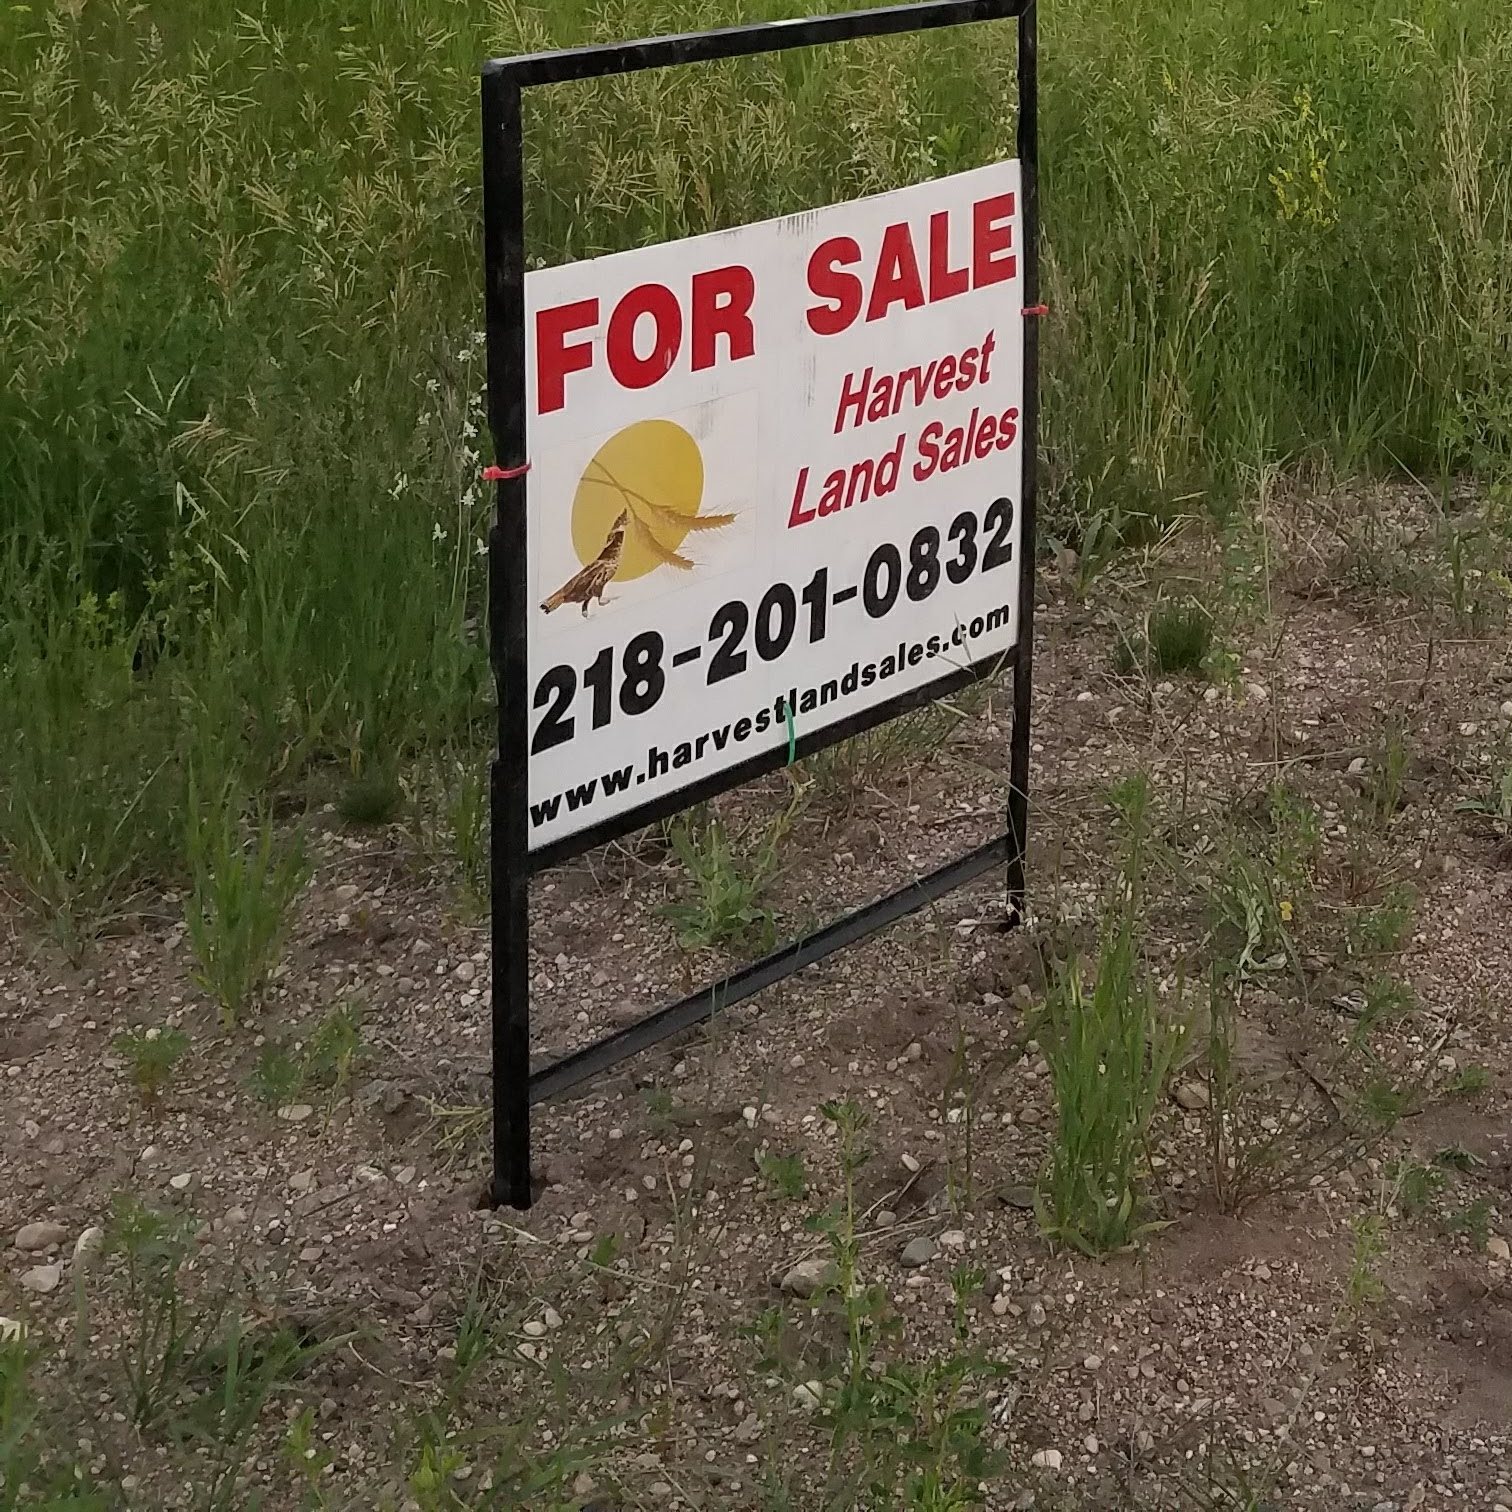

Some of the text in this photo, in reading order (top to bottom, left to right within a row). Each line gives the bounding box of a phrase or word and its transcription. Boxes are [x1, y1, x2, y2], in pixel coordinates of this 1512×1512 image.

[535, 191, 1017, 415] FOR SALE
[834, 330, 995, 435] Harvest
[788, 404, 1020, 529] Land Sales
[529, 603, 1010, 828] www.harvestlandsales.com
[530, 496, 1014, 757] 218-201-0832
